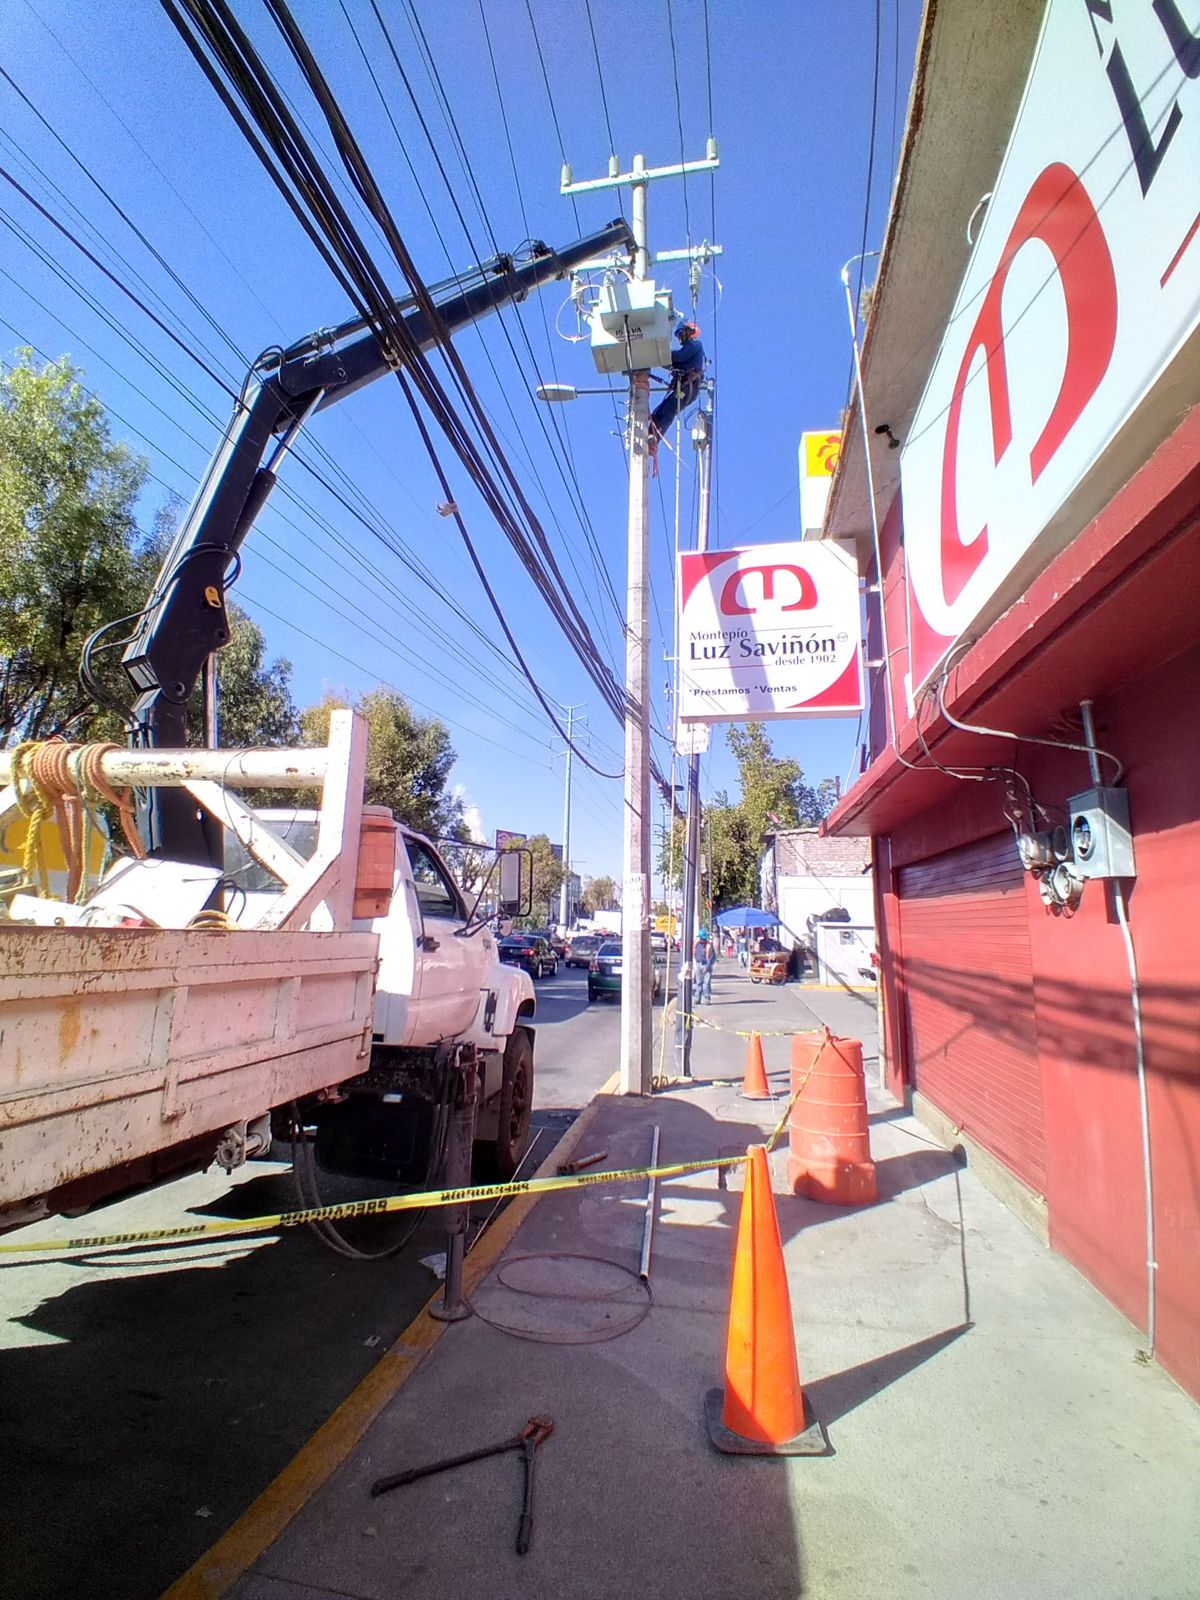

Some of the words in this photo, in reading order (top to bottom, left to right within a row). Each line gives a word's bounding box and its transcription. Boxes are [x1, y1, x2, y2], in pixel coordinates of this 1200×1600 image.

[690, 628, 748, 642] Montepío
[690, 642, 731, 660] Luz
[740, 633, 836, 658] Saviñón
[775, 656, 805, 666] desde
[810, 655, 836, 664] 1902
